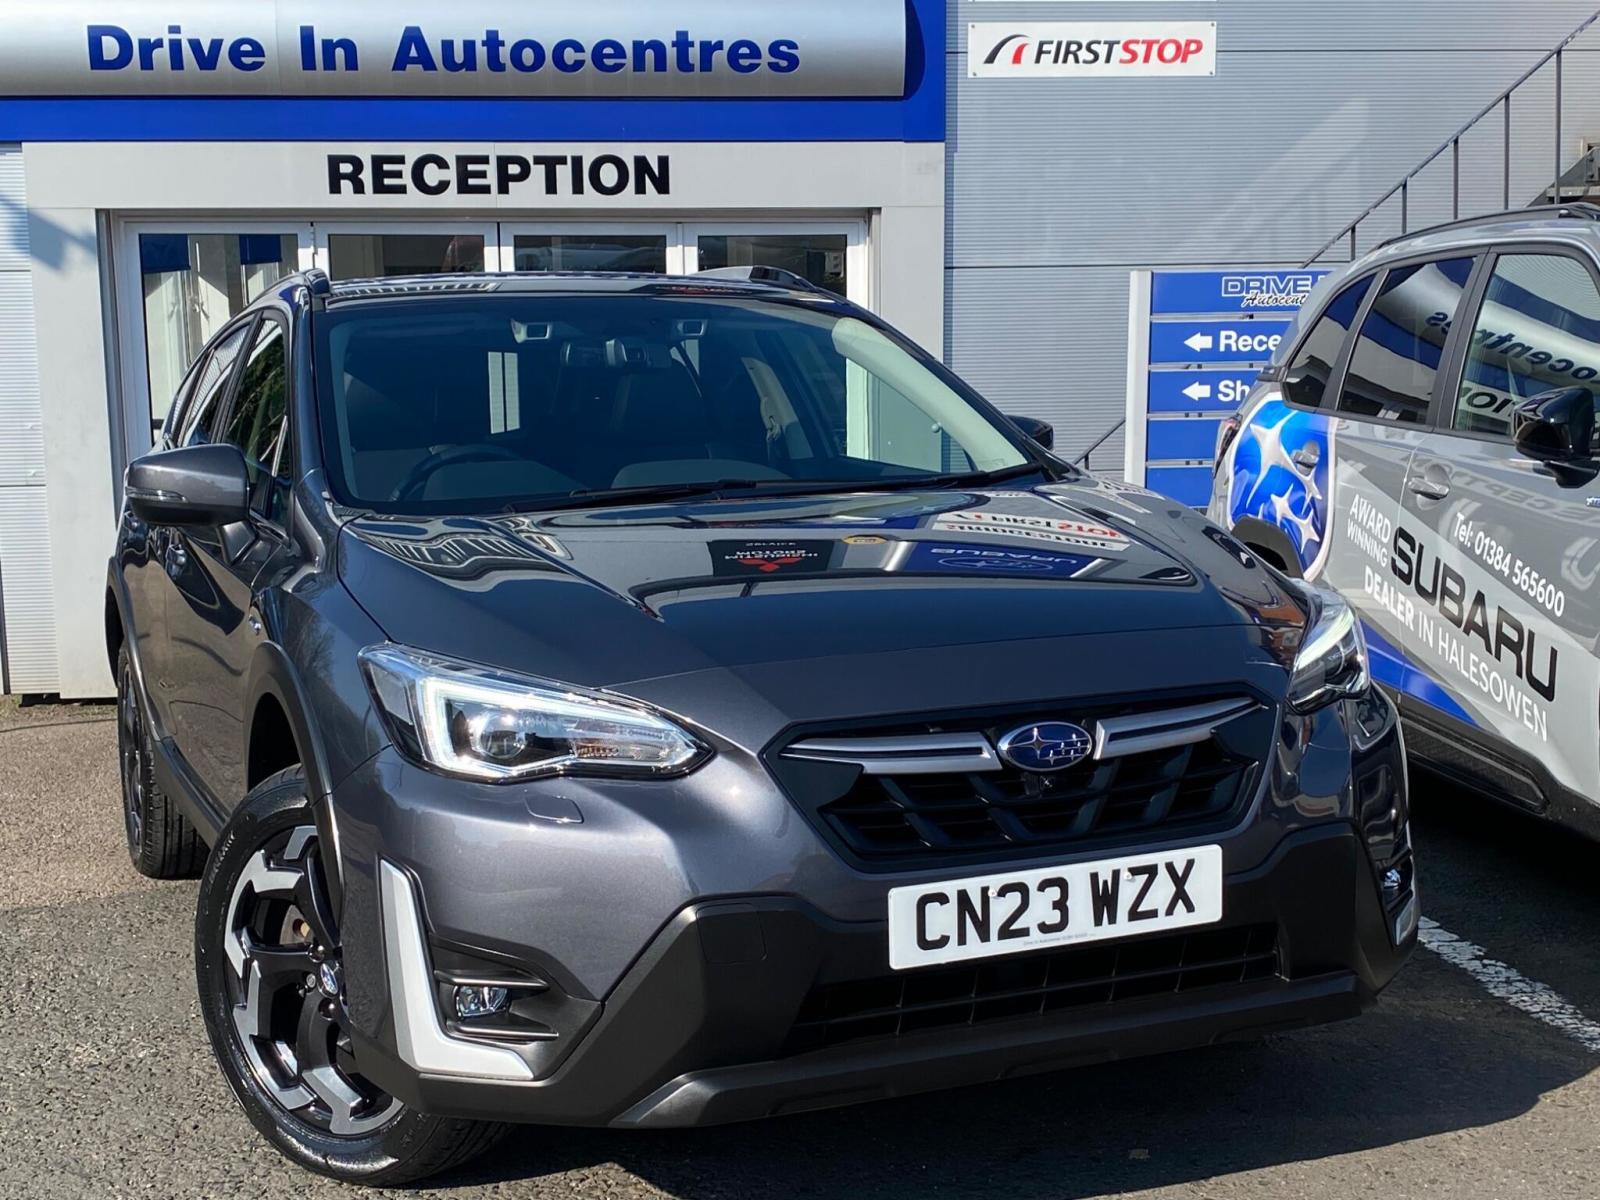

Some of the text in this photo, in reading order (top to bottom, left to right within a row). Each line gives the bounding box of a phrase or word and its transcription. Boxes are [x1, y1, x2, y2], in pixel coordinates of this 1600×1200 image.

[86, 24, 801, 73] Drive In Autocentres
[326, 153, 671, 196] RECEPTION
[1222, 275, 1313, 297] DRIVE
[1346, 518, 1388, 568] WINNING
[1349, 493, 1392, 544] AWARD
[1454, 511, 1565, 617] Tel: 01384 565600
[1390, 526, 1558, 702] SUBARU
[1364, 564, 1548, 742] DEALER IN HALESOWEN
[915, 858, 1196, 952] CN23 WZX
